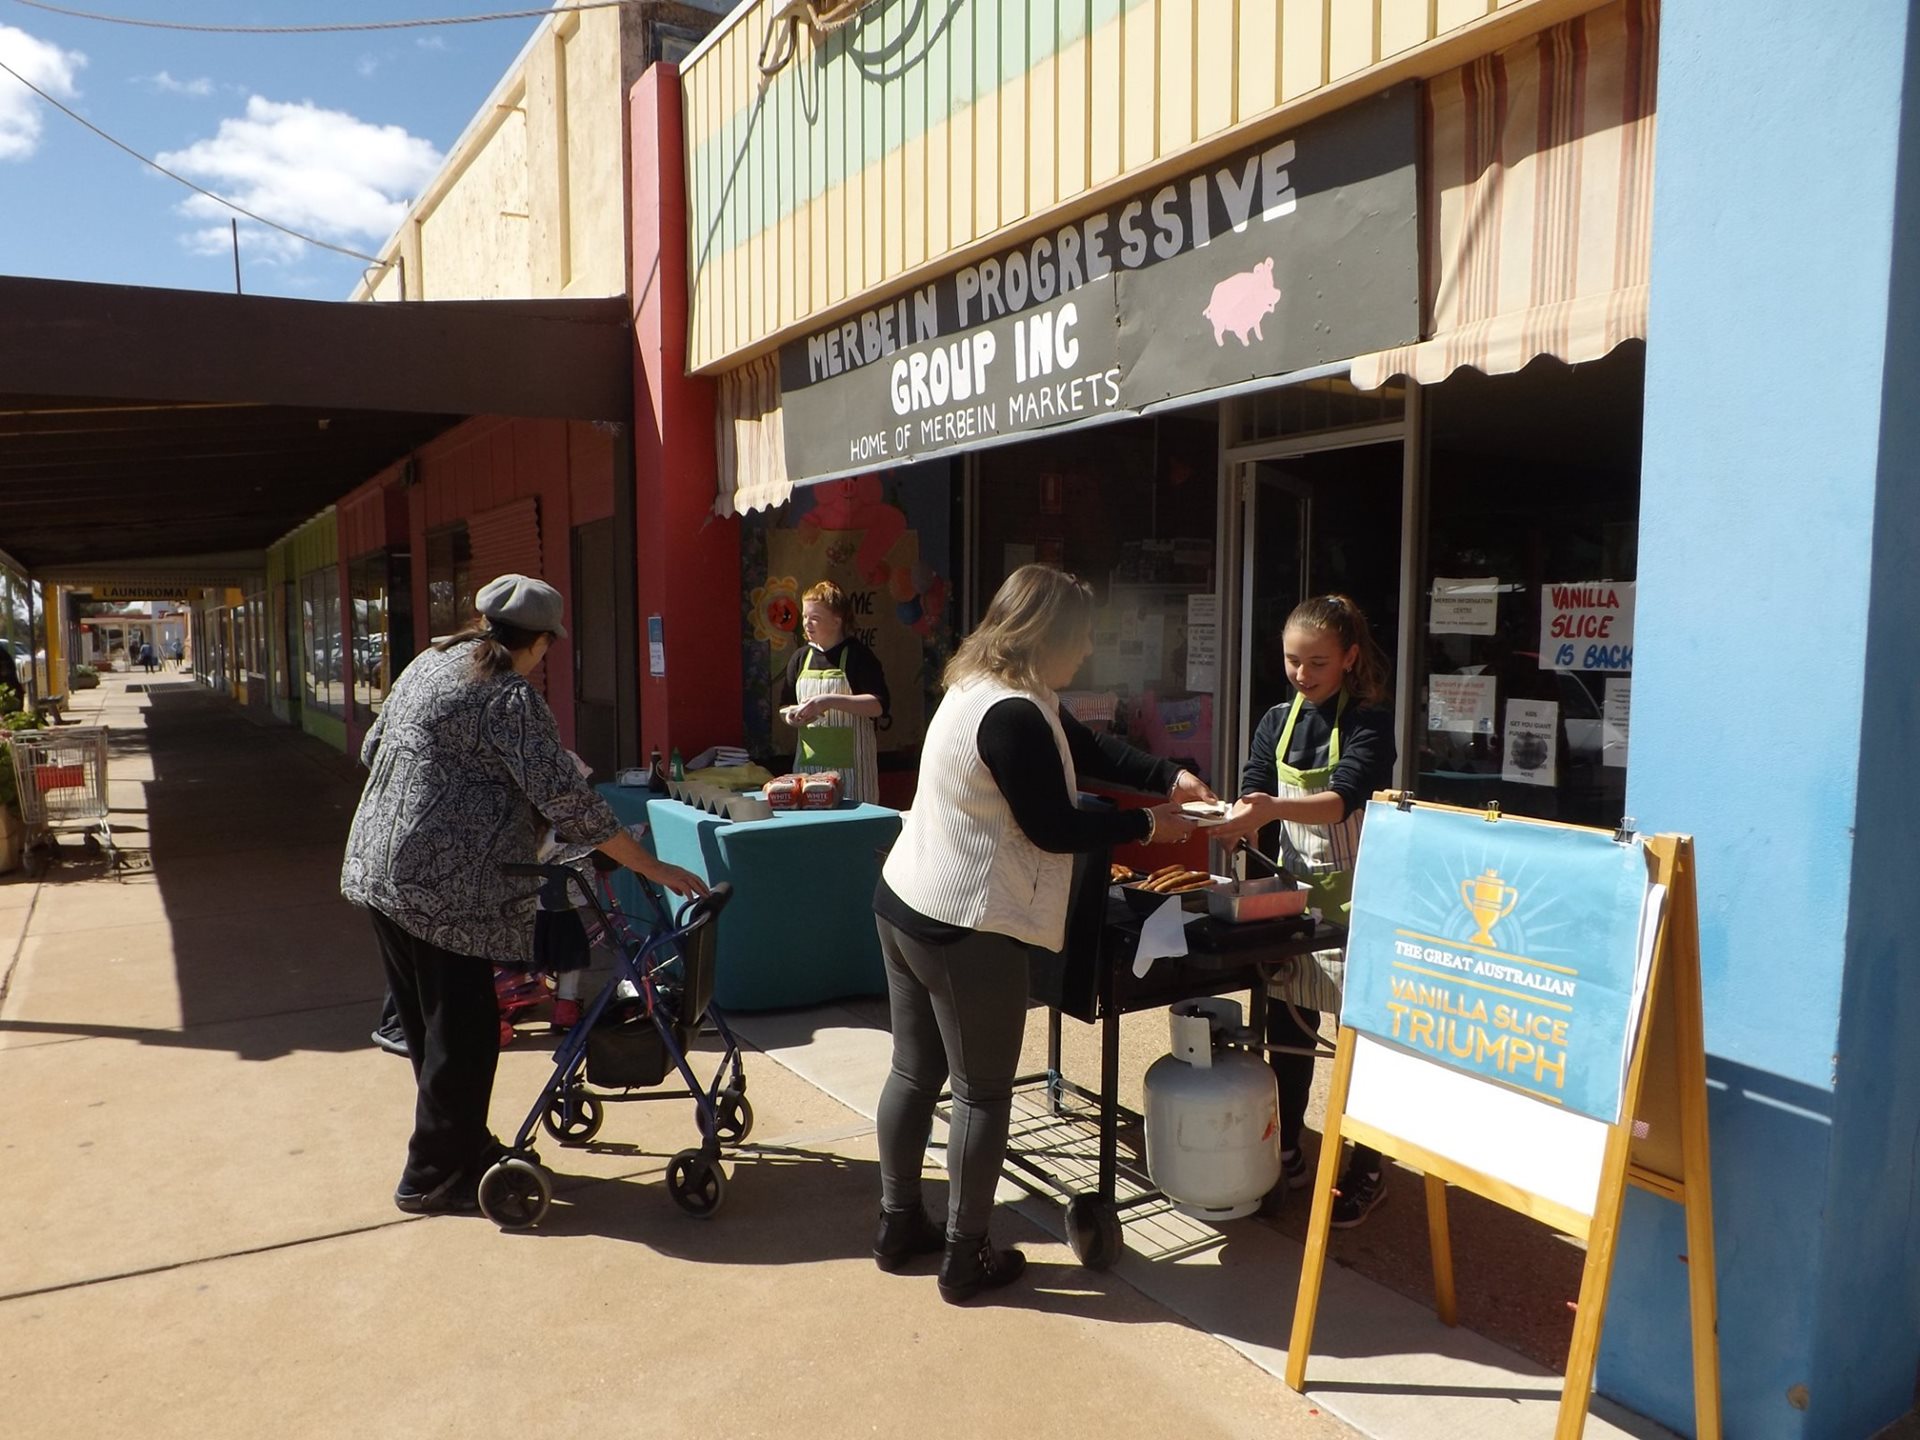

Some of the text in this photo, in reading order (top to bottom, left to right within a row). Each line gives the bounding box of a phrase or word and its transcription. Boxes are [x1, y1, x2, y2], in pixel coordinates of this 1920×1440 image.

[807, 139, 1297, 383] MERBEIN PROGRESSIVE
[890, 302, 1080, 416] GROUP INC
[850, 368, 1121, 462] HOME OF MERBEIN MARKETS
[1550, 614, 1614, 638] SLICE
[1551, 586, 1620, 610] VANILLA
[1555, 643, 1633, 669] IS BACK
[805, 792, 828, 800] WHITE
[1394, 940, 1577, 998] THE GREAT AUSTRALIAN
[1389, 975, 1570, 1047] VANILLA SLICE
[1386, 1001, 1568, 1090] TRIUMPH
